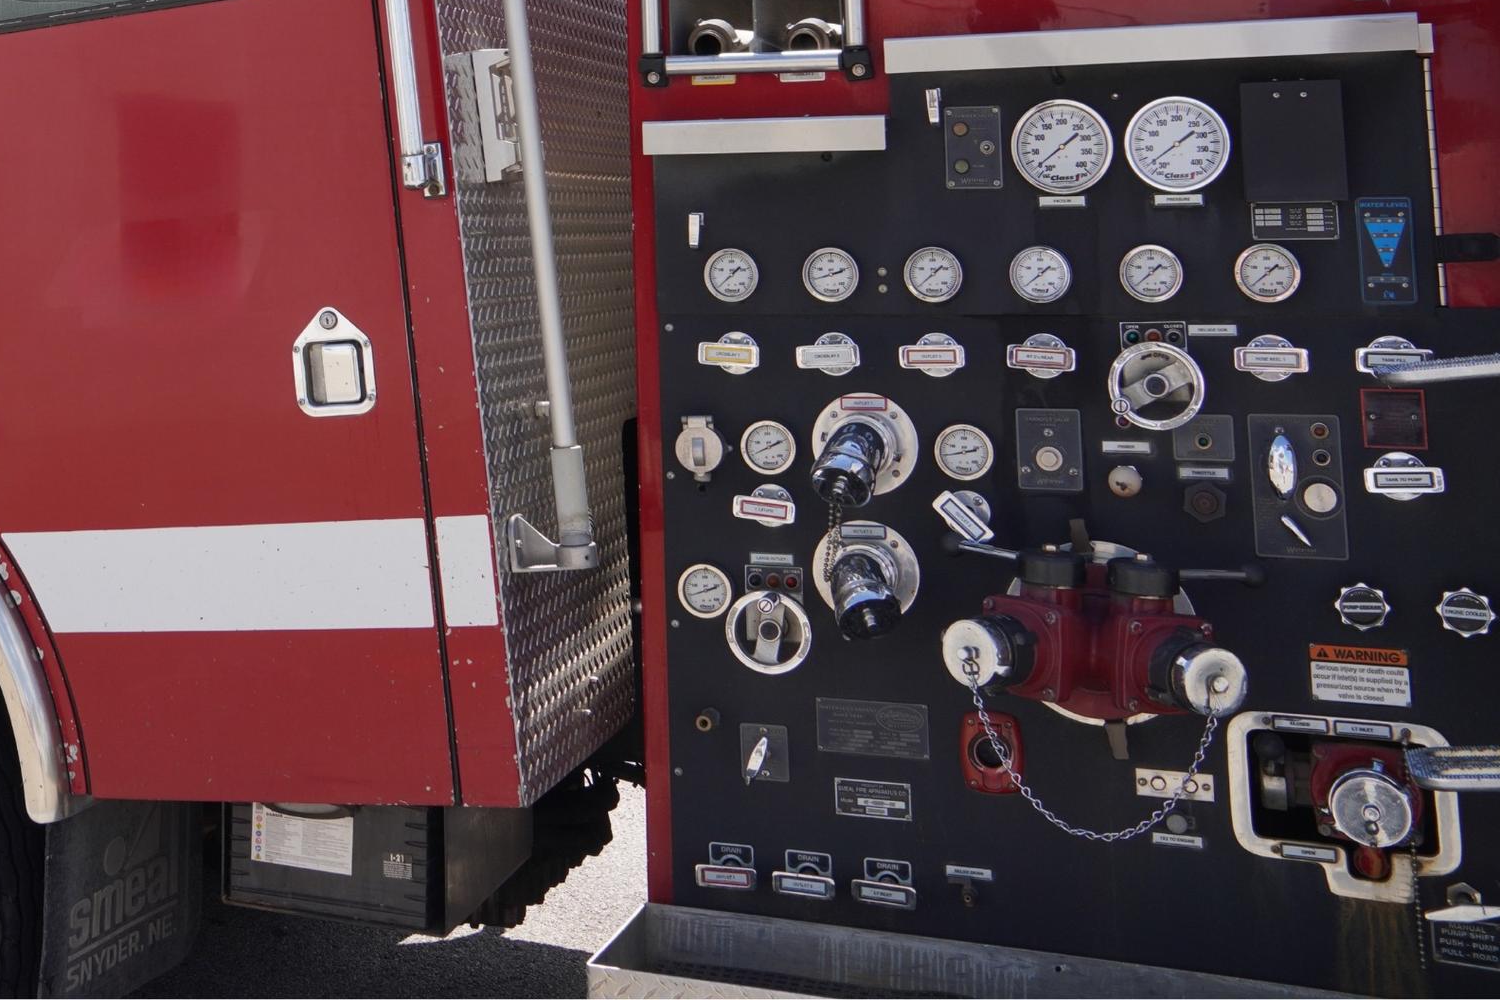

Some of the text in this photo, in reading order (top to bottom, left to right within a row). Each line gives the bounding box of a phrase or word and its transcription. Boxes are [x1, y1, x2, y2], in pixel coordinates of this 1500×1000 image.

[1055, 118, 1068, 126] 200
[1170, 114, 1183, 122] 200
[1041, 123, 1053, 131] 150
[1072, 123, 1085, 131] 250
[1156, 119, 1168, 127] 150
[1187, 120, 1200, 128] 250
[1034, 133, 1046, 141] 100
[1195, 131, 1208, 139] 300
[1031, 148, 1040, 156] 50
[1196, 145, 1209, 153] 350
[1075, 160, 1088, 168] 400
[1190, 158, 1203, 166] 400
[1334, 648, 1400, 663] WARNING
[1315, 664, 1339, 672] Serious
[1366, 667, 1385, 675] death
[1386, 668, 1404, 676] could
[1365, 676, 1393, 686] supplied
[1394, 678, 1402, 687] by
[1316, 682, 1353, 691] pressurized
[721, 846, 742, 855] DRAIN
[797, 854, 819, 864] DRAIN
[876, 861, 899, 871] DRAIN
[68, 830, 180, 950] smeal
[1441, 927, 1495, 942] PUMP SHIFT
[1439, 937, 1500, 952] PUSH PUMP
[1441, 947, 1499, 962] PULL ROAD
[66, 929, 144, 992] SNYDER,
